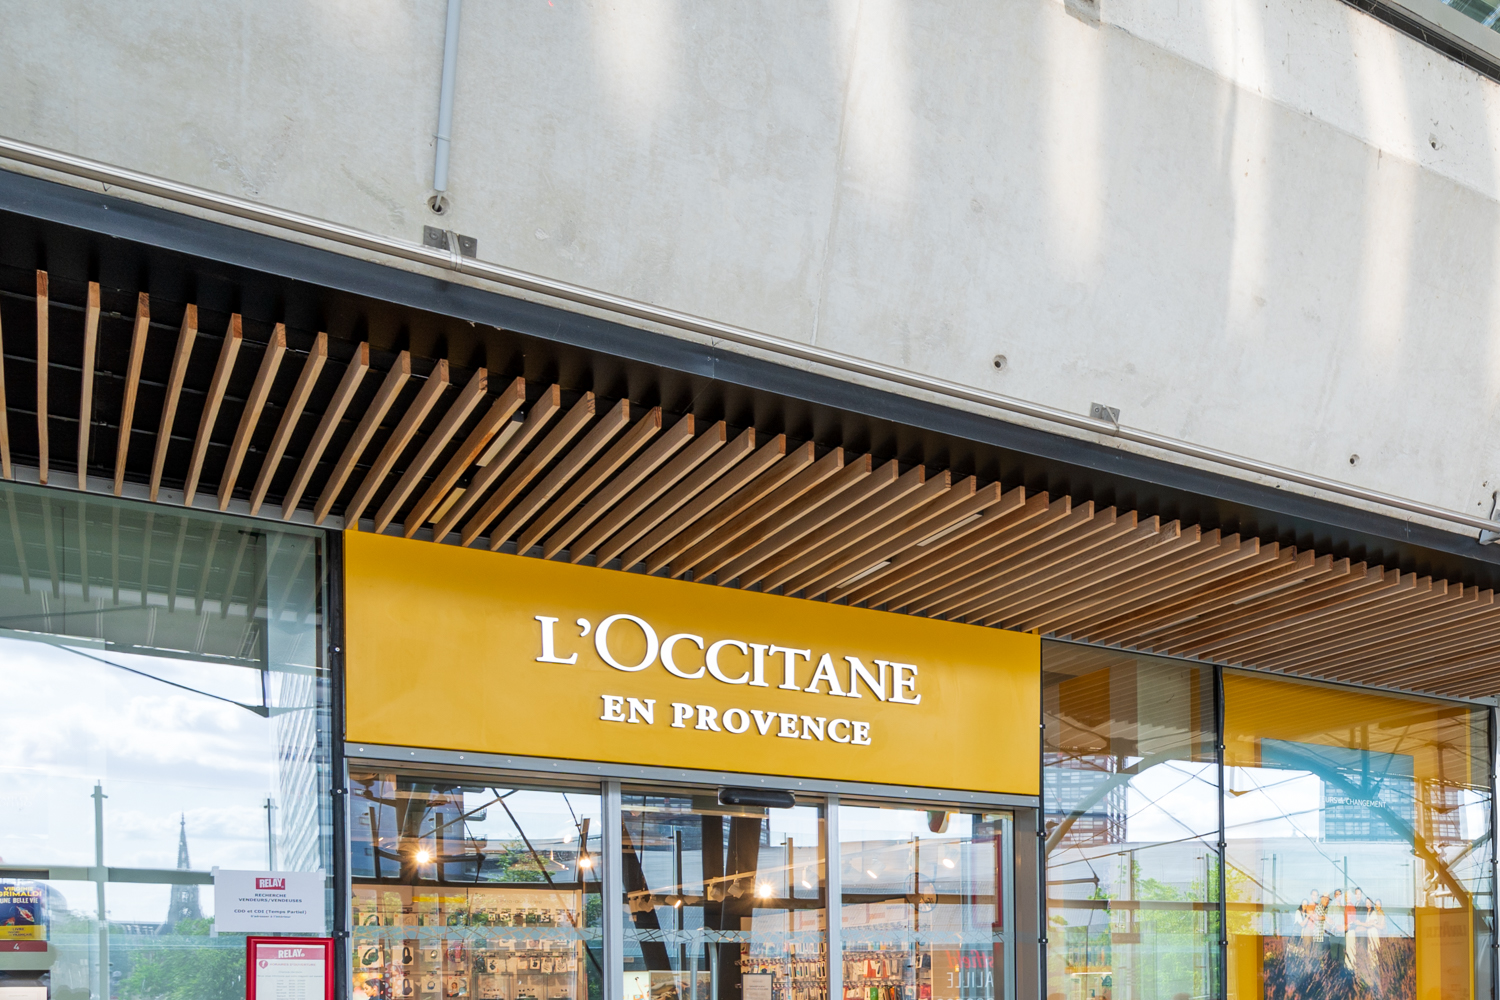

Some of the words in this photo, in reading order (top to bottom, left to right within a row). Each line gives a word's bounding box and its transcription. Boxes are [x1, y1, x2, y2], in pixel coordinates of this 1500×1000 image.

[534, 613, 922, 706] L'OCCITANE
[600, 694, 656, 725] EN
[670, 701, 872, 747] PROVENCE
[259, 878, 283, 889] RELAY
[13, 942, 20, 950] 4
[278, 948, 303, 959] RELAY
